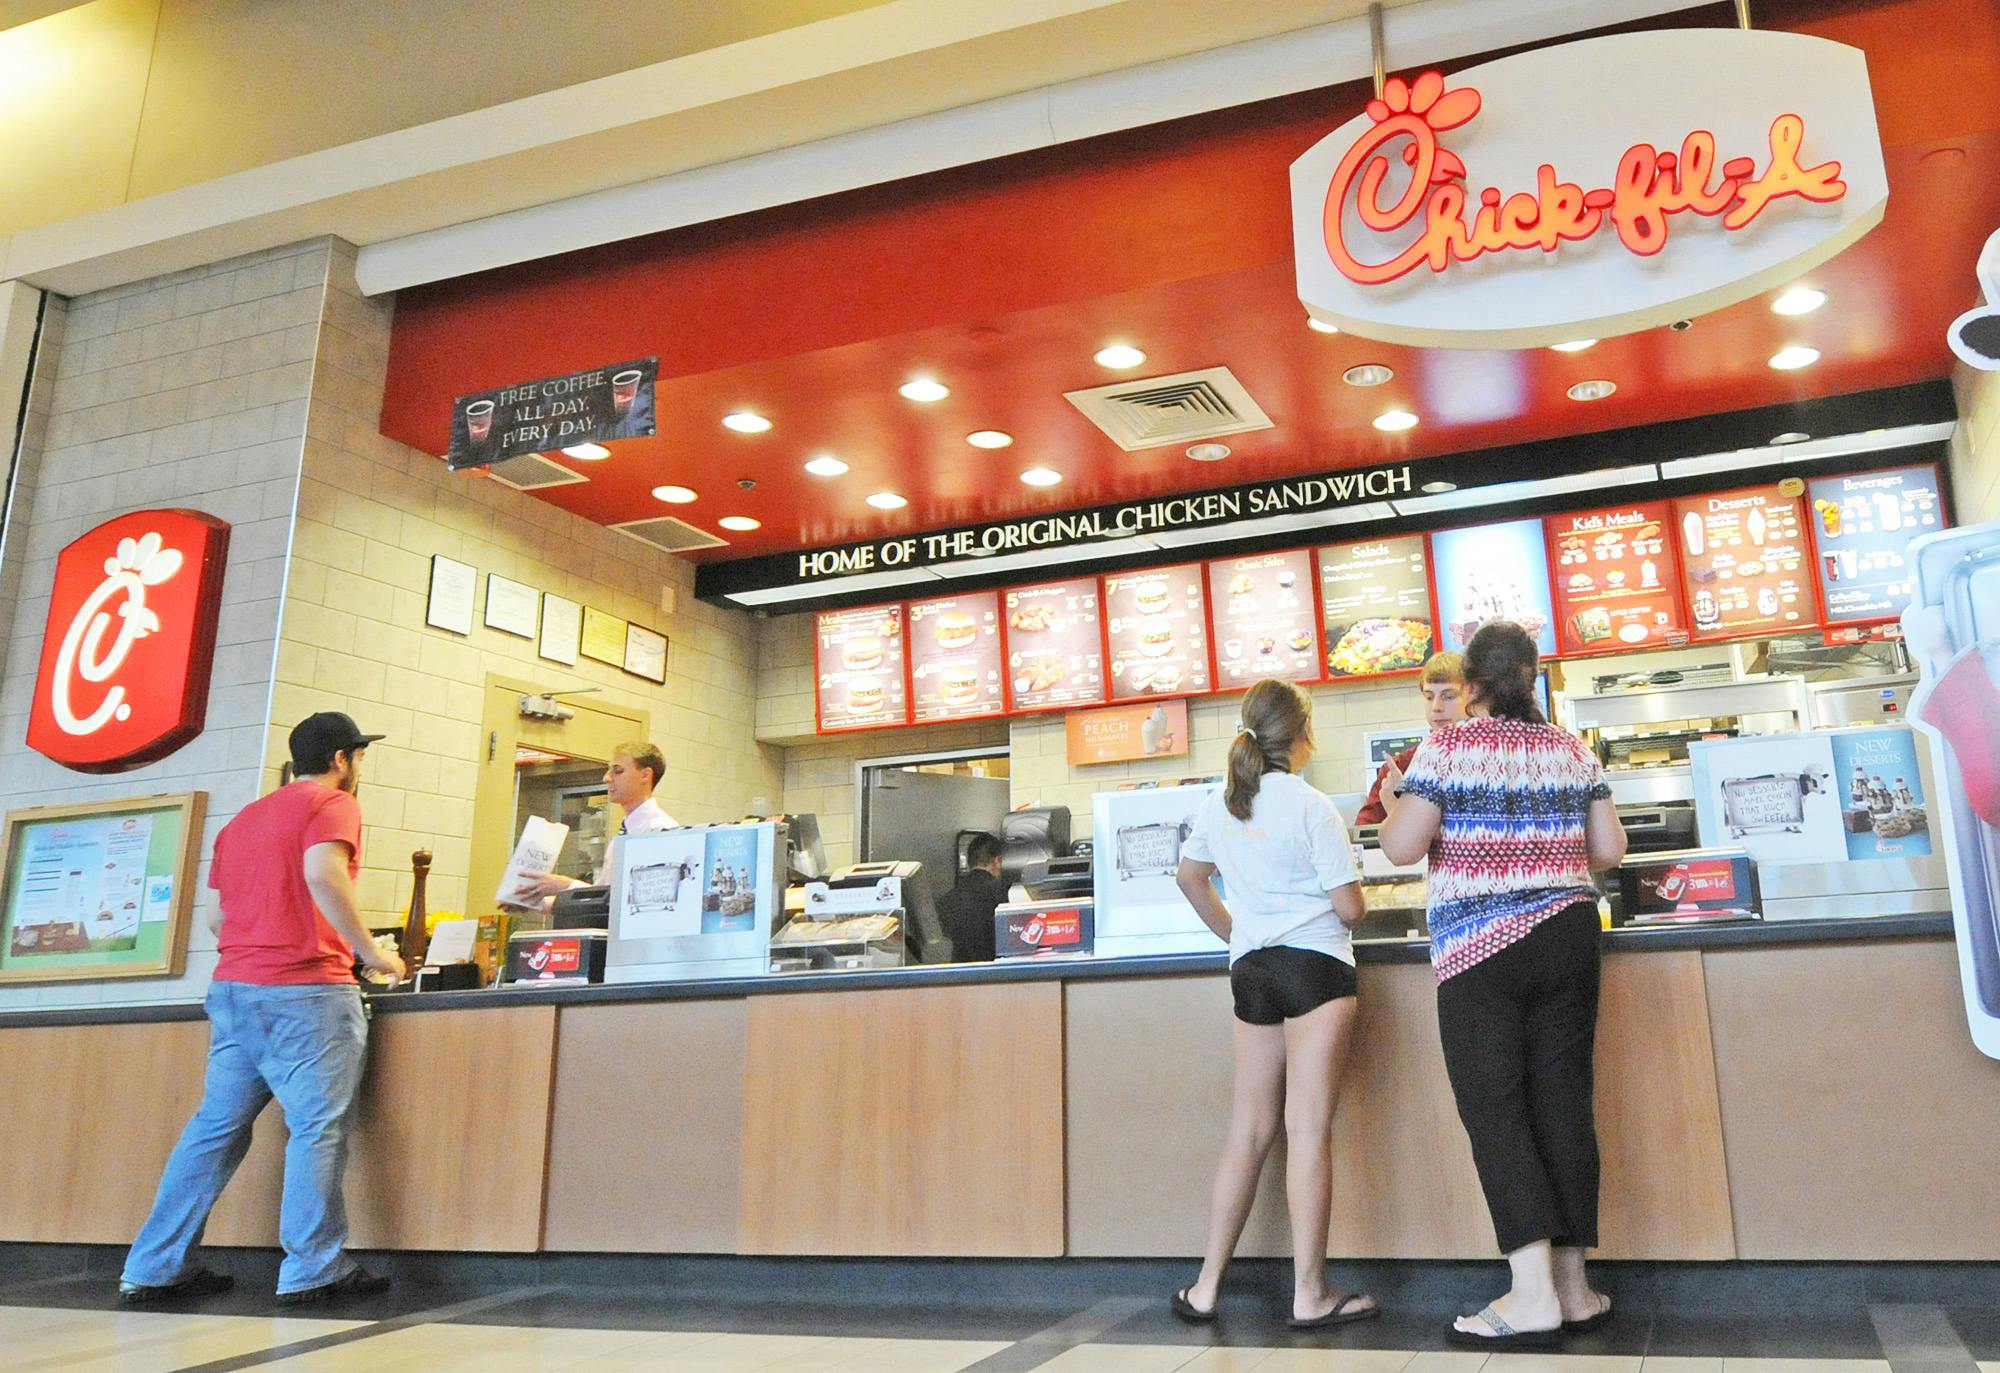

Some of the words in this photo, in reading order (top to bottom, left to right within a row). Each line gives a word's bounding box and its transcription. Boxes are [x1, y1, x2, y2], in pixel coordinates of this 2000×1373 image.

[1324, 72, 1846, 285] Chick-fil-A
[500, 387, 538, 407] FREE
[542, 371, 608, 397] COFFEE.
[514, 406, 544, 423] ALL
[551, 396, 590, 417] DAY.
[502, 422, 552, 449] EVERY
[559, 416, 597, 437] DAY.
[1843, 475, 1904, 492] Beverages
[1708, 495, 1767, 512] Desserts
[799, 545, 874, 577] HOME
[880, 539, 916, 566] OF
[922, 530, 975, 560] THE
[982, 511, 1109, 551] ORIGINAL
[1115, 491, 1241, 530] CHICKEN
[1248, 466, 1412, 513] SANDWICH
[1572, 515, 1603, 531] Kid's
[1605, 510, 1645, 525] Meals
[1351, 543, 1389, 560] Salads
[1106, 580, 1119, 595] 7
[1007, 593, 1019, 608] 5
[911, 607, 923, 621] 3
[1110, 618, 1123, 634] 8
[821, 635, 831, 649] 1
[1010, 652, 1022, 667] 6
[913, 664, 926, 679] 4
[1111, 660, 1125, 677] 9
[820, 674, 832, 689] 2
[1085, 720, 1129, 737] PEACH
[1855, 737, 1892, 753] NEW
[1850, 752, 1902, 767] DESSERTS
[1641, 878, 1659, 887] New
[1009, 925, 1024, 933] New
